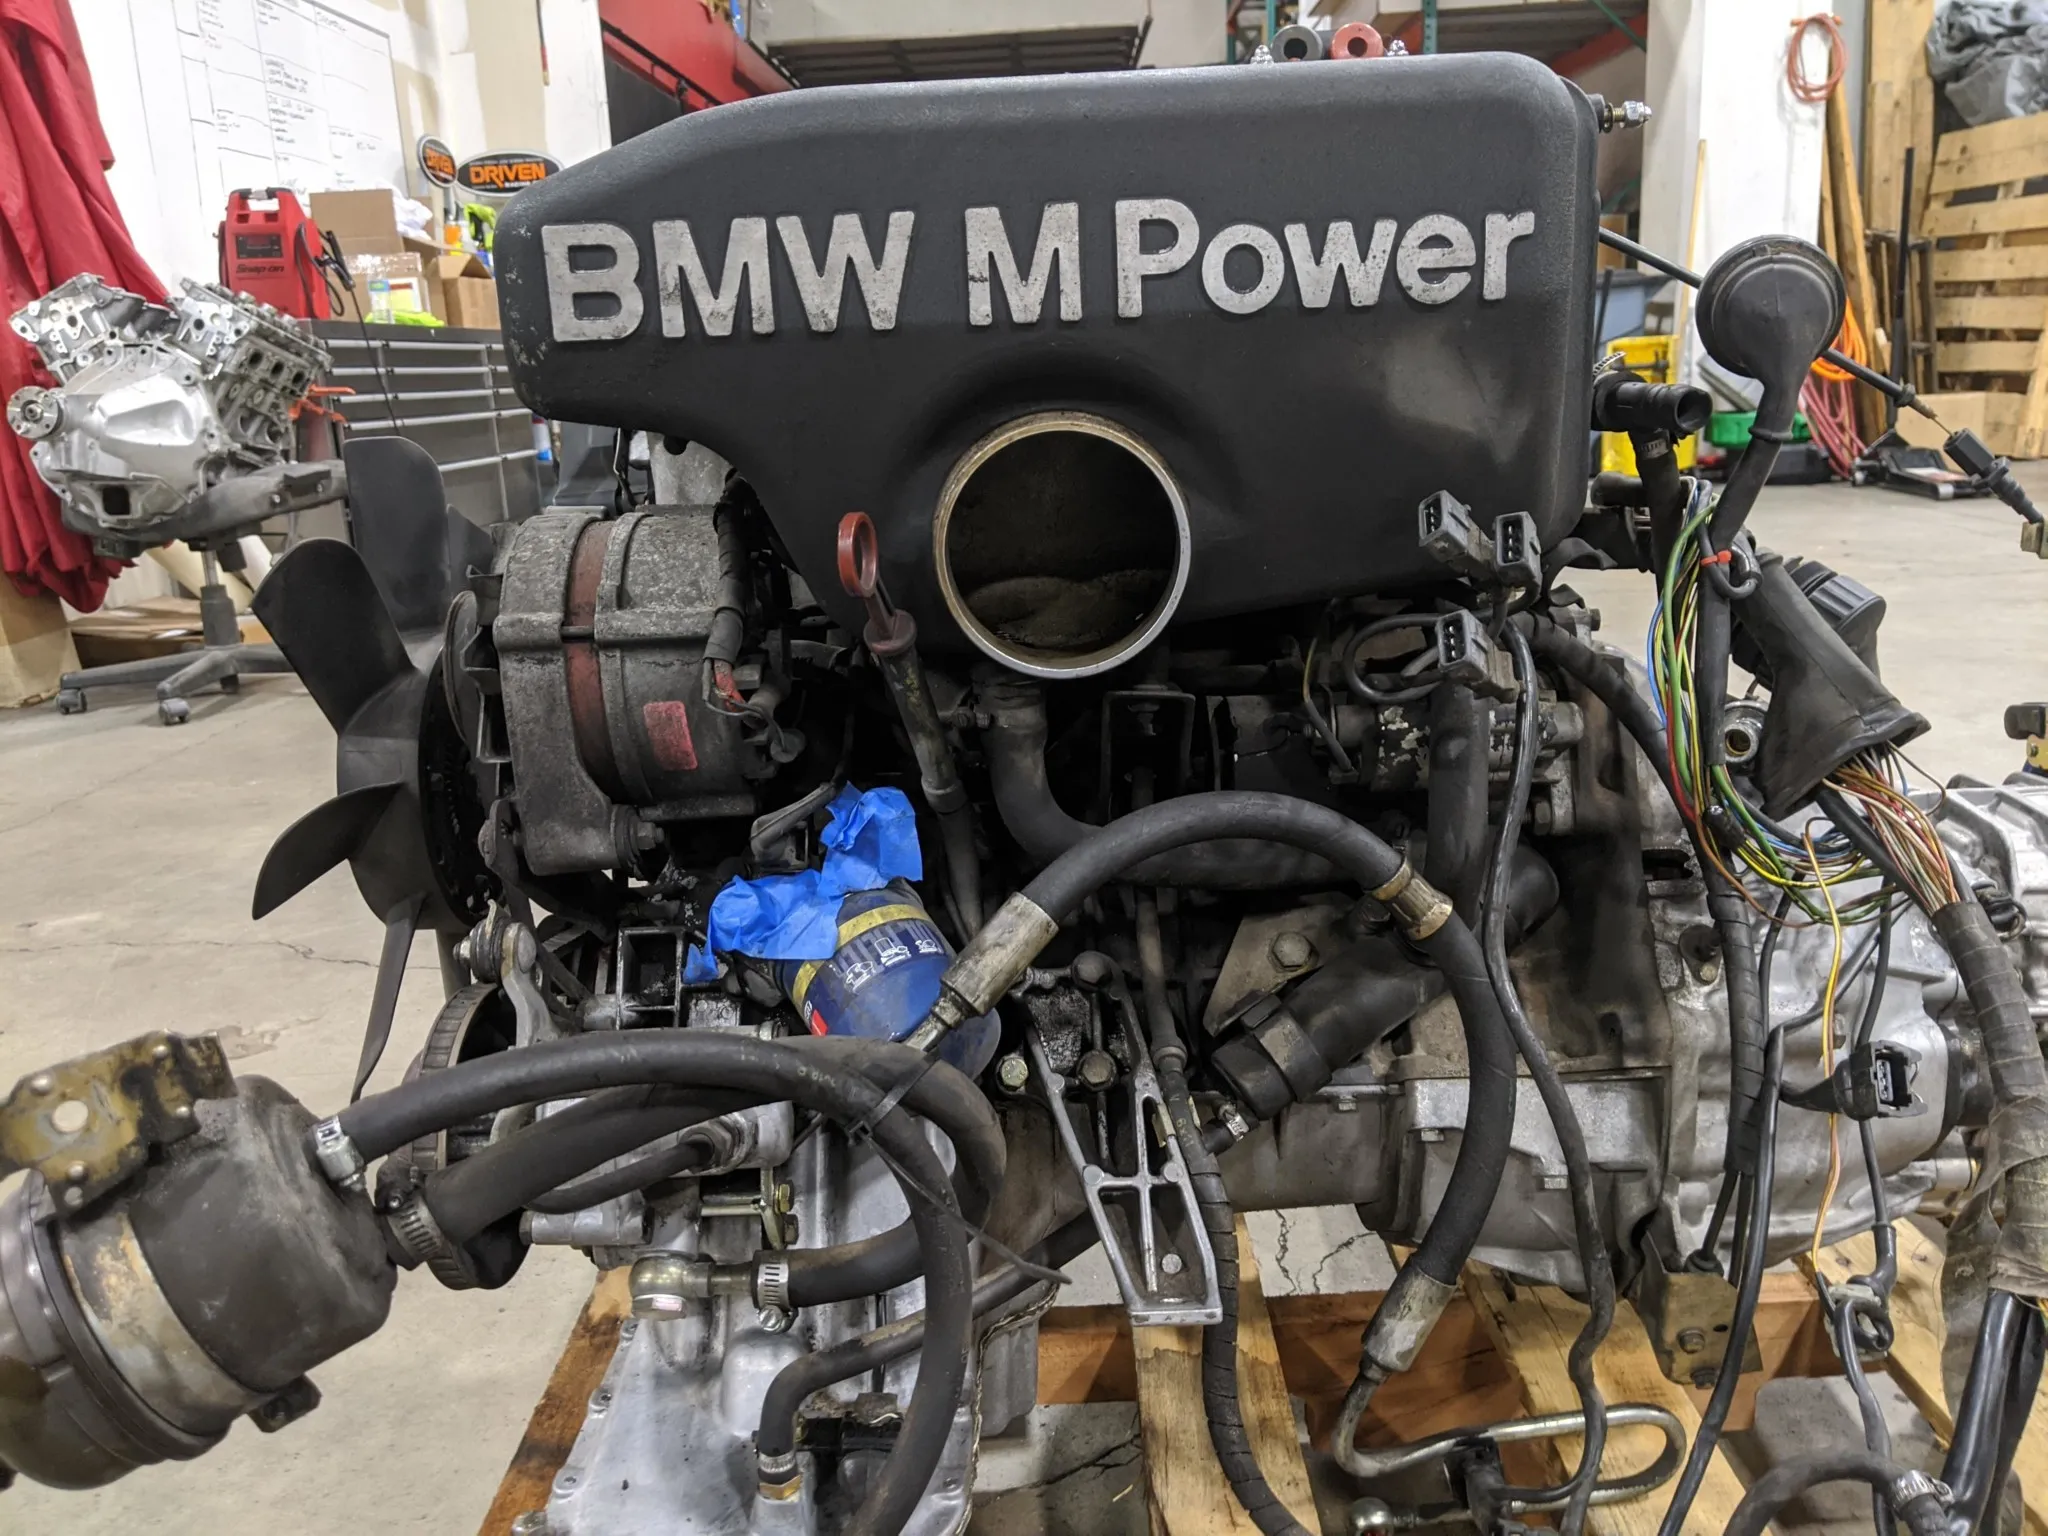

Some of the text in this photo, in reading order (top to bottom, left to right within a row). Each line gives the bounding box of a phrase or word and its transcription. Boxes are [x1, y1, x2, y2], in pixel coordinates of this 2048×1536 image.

[469, 162, 546, 189] DRIVEN
[237, 264, 284, 274] Snap-on
[541, 198, 1536, 343] BMW M Power
